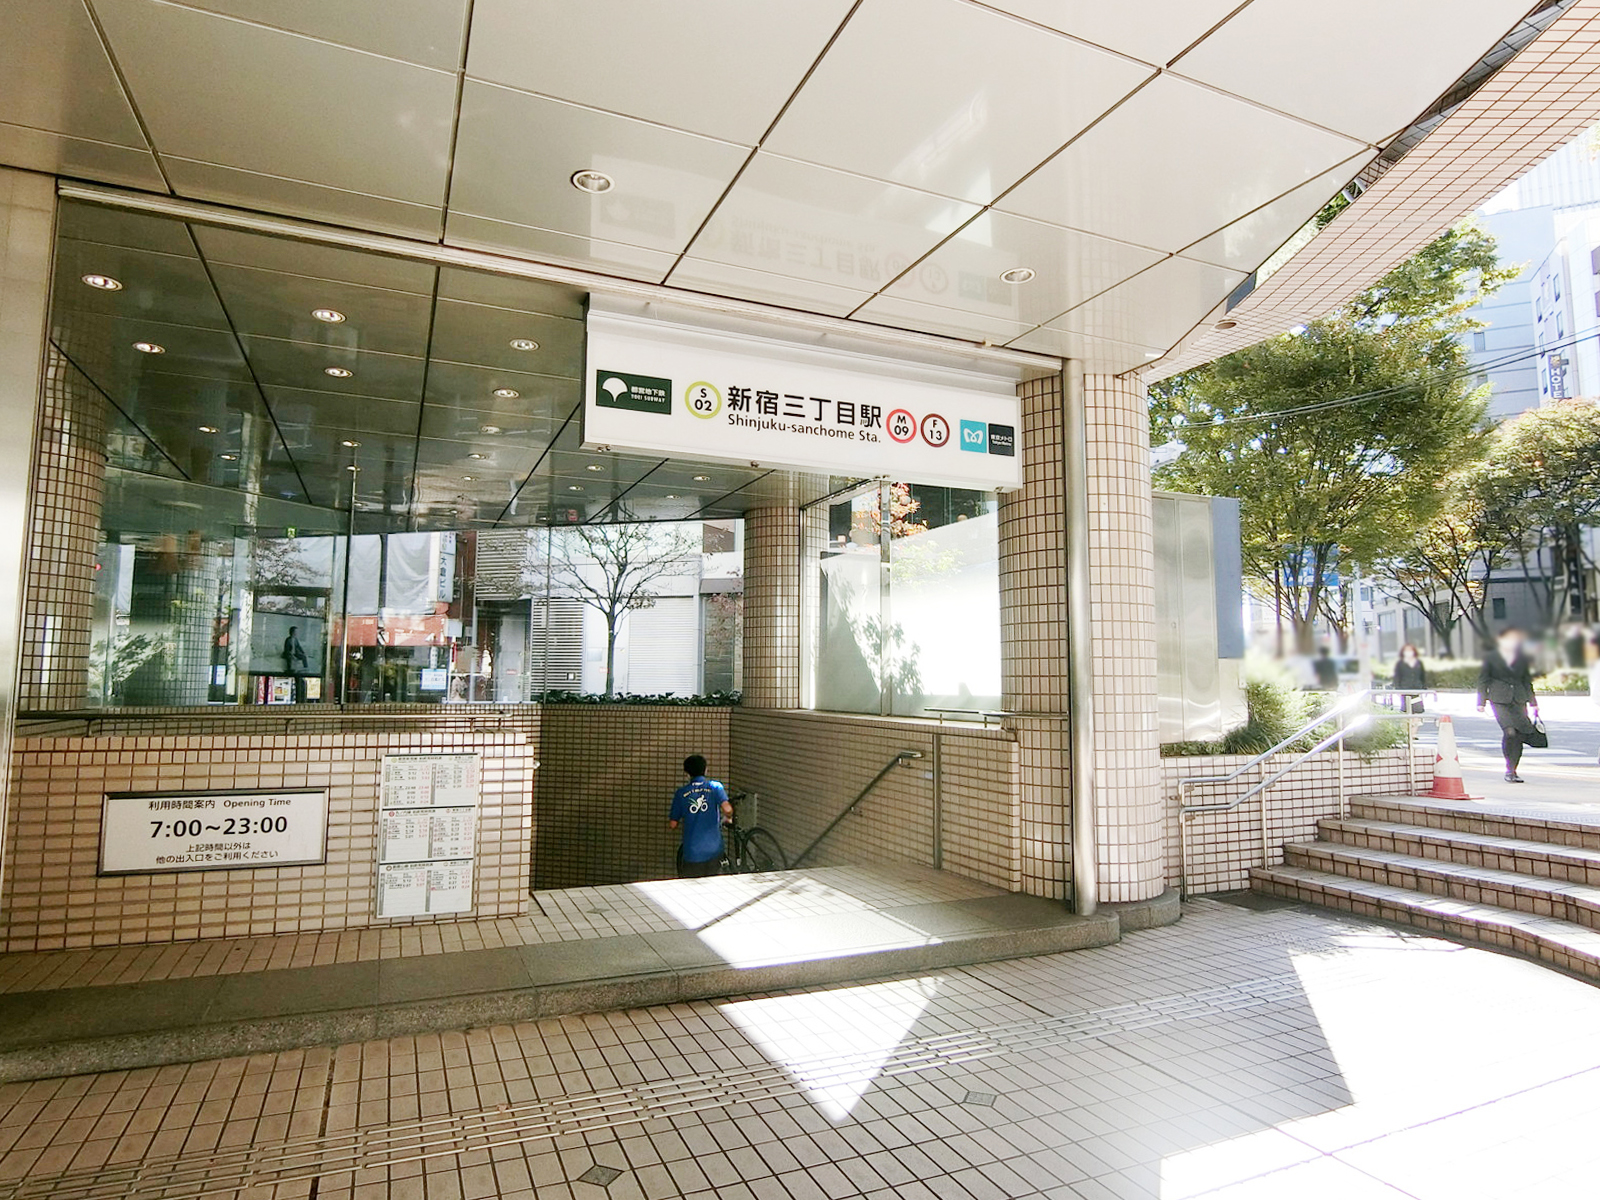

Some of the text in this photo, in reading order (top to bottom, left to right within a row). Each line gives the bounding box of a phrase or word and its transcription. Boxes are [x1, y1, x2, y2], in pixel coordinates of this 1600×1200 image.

[700, 388, 707, 398] S
[694, 399, 712, 411] 02
[727, 385, 882, 429] 新宿三丁目駅
[897, 415, 907, 425] M
[932, 419, 938, 428] F
[728, 413, 882, 443] Shinjuku-sanchome Sta.
[894, 426, 909, 437] 09
[930, 429, 943, 441] 13
[148, 798, 292, 811] 利用時間案内 Opening Time
[186, 842, 251, 853] 上記時間以外は
[156, 850, 279, 864] 他の出入口をご利用ください
